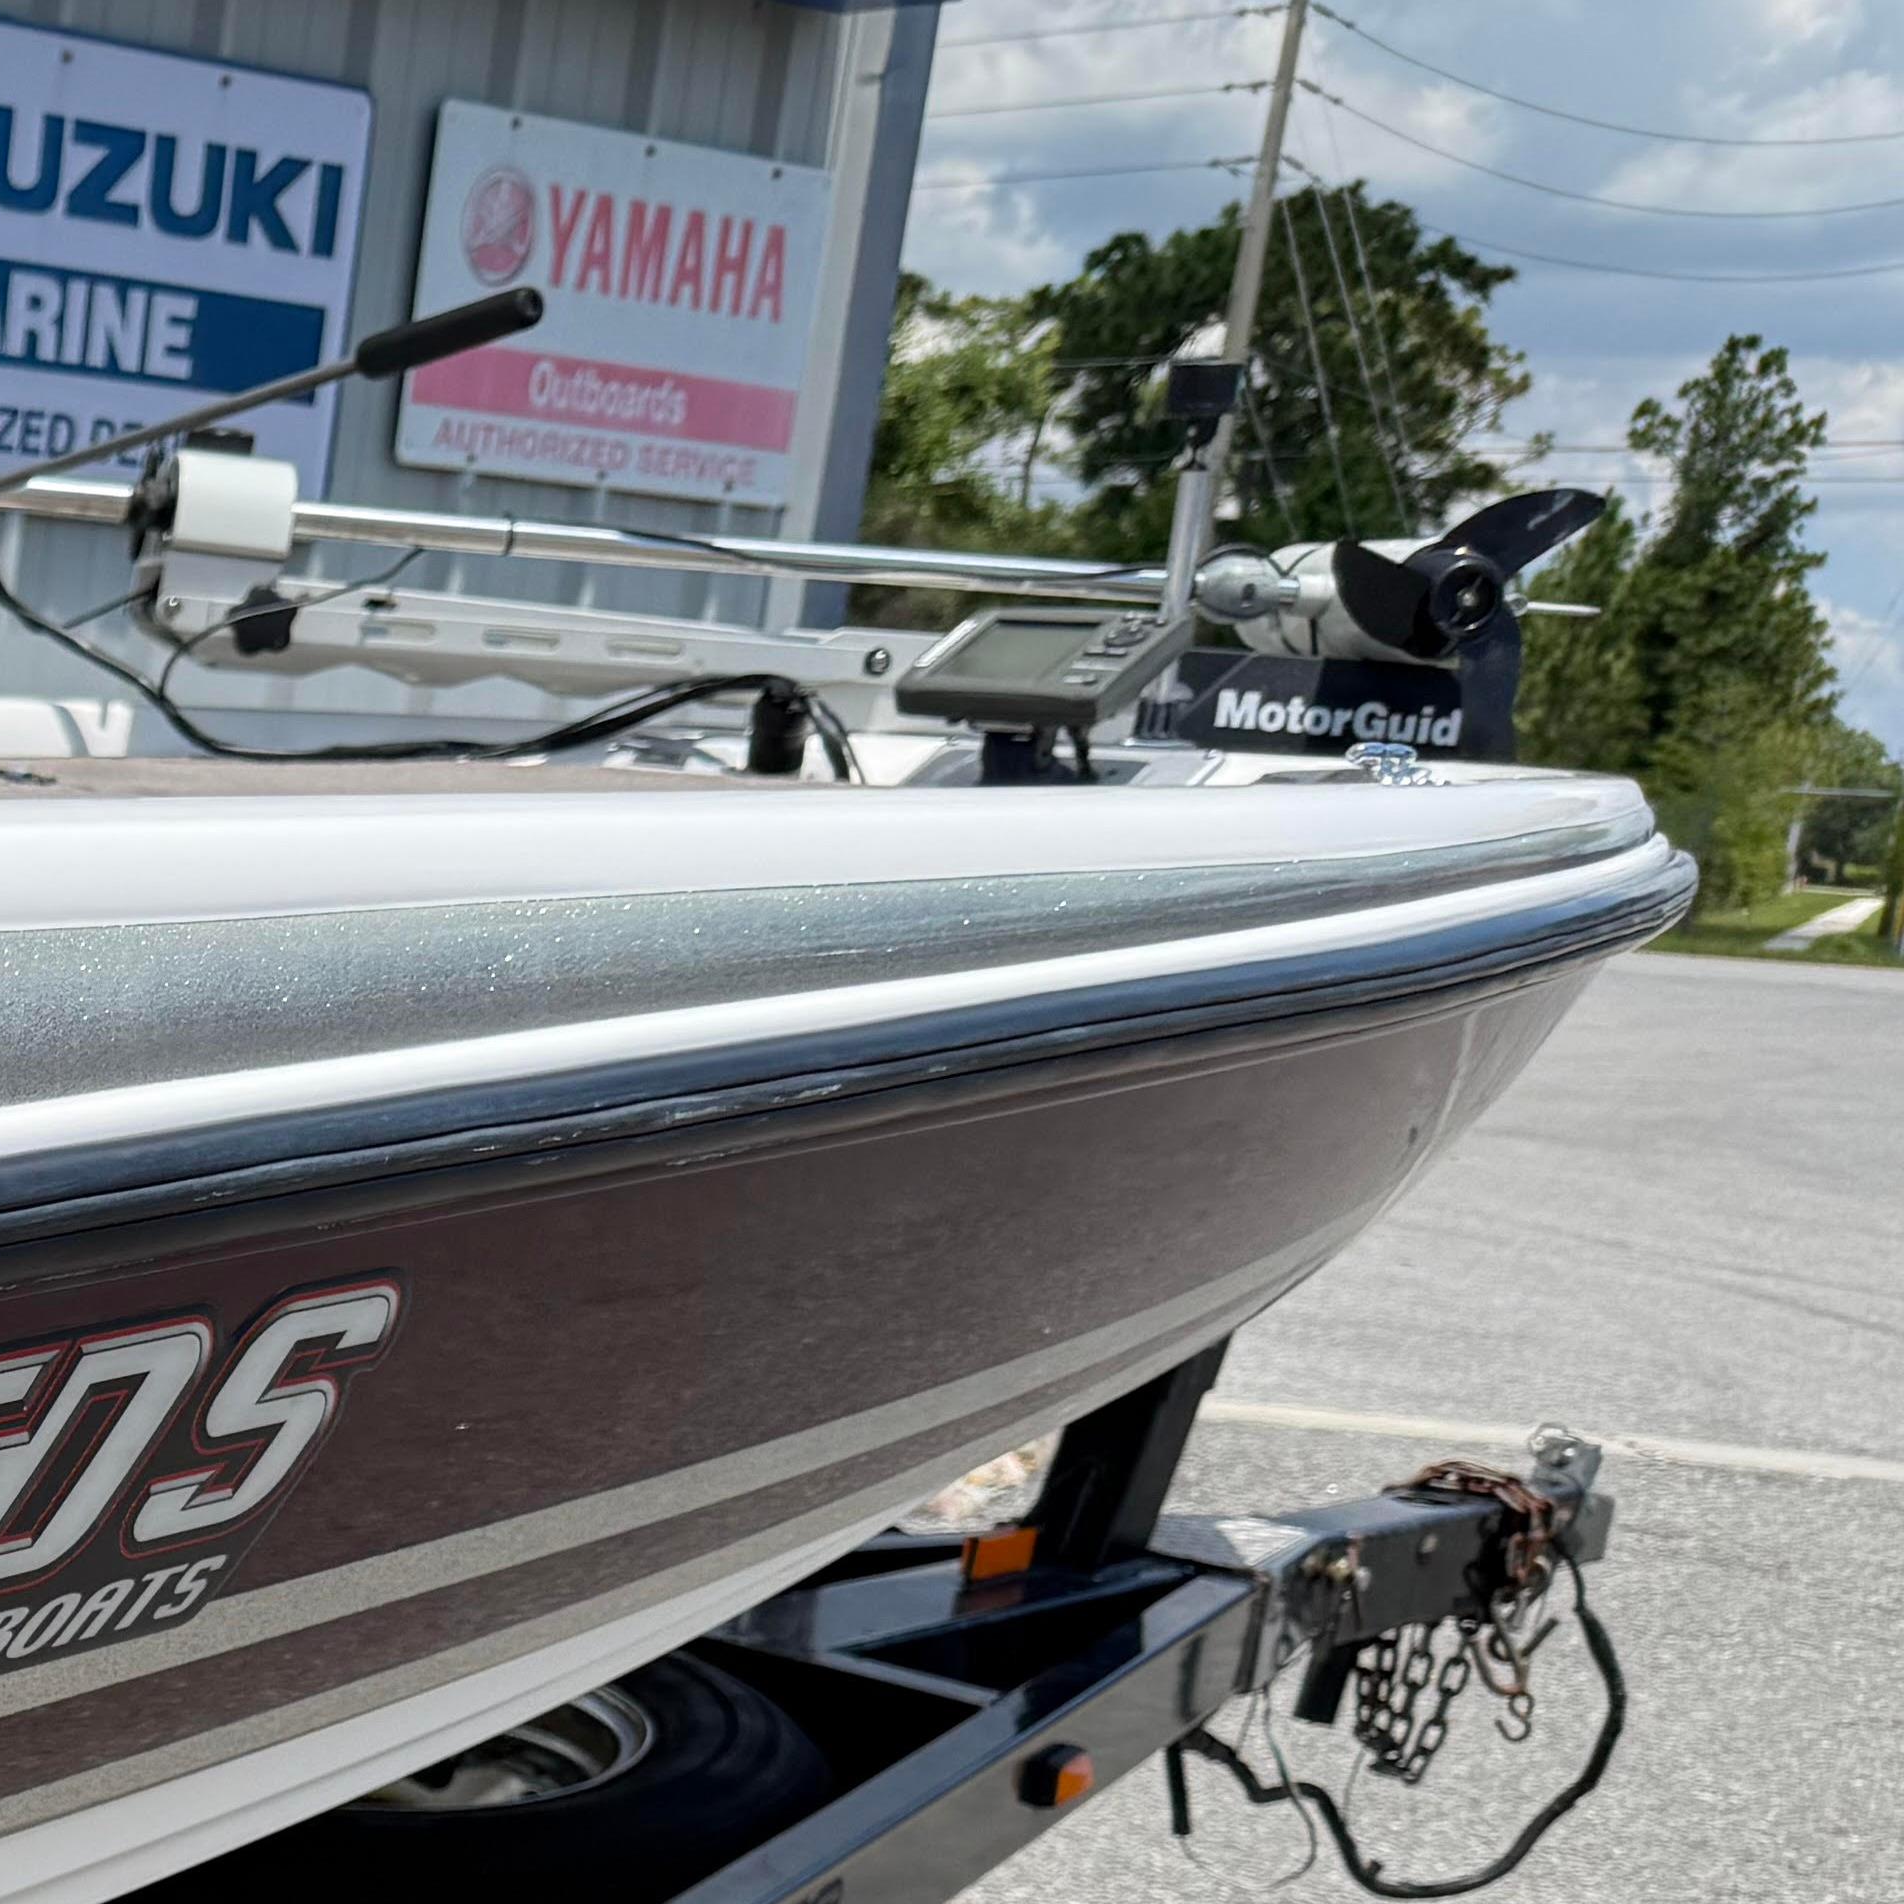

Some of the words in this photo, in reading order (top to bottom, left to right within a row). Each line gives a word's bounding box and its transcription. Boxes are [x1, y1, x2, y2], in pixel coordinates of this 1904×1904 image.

[548, 183, 787, 323] YAMAHA
[529, 360, 688, 425] Outboards
[432, 416, 630, 472] AUTHORIZED
[635, 444, 758, 486] SERVICE
[1214, 688, 1462, 747] MotorGuid
